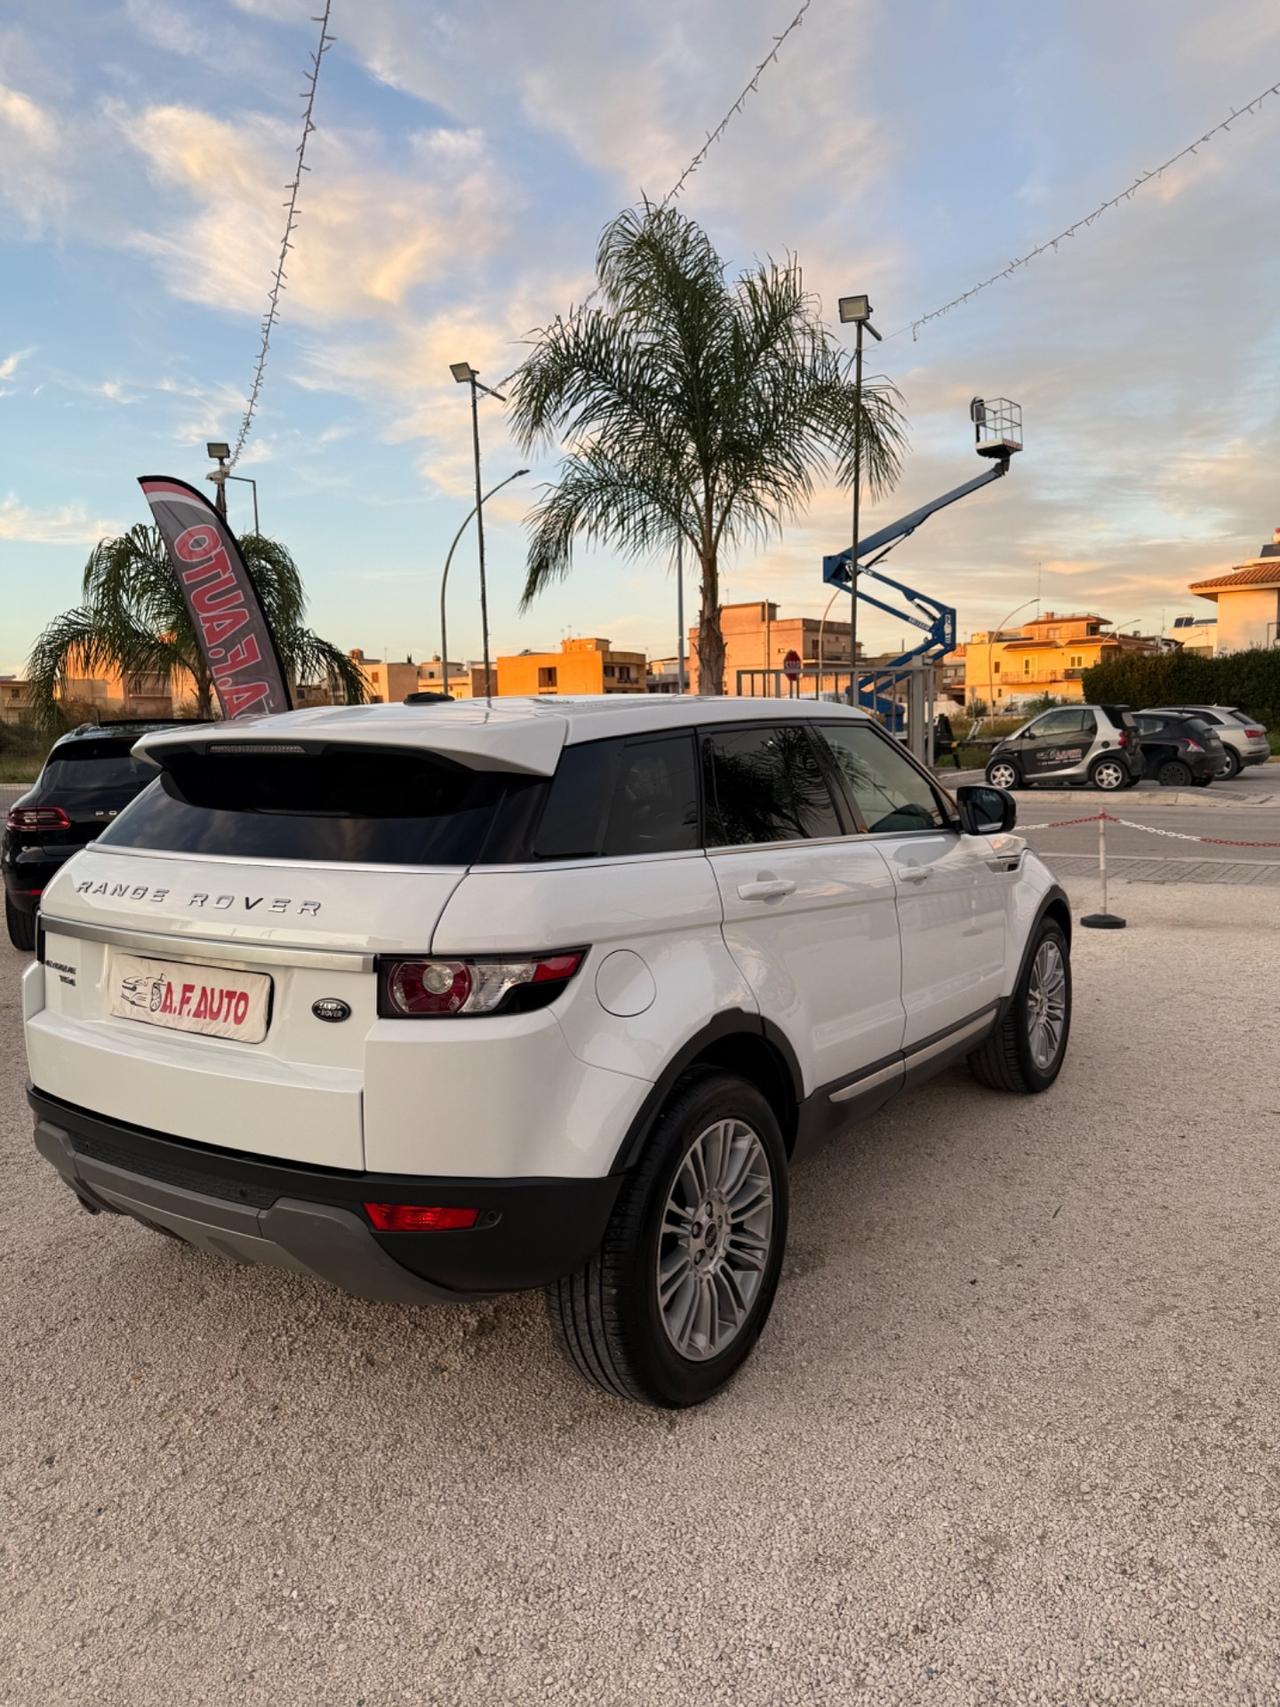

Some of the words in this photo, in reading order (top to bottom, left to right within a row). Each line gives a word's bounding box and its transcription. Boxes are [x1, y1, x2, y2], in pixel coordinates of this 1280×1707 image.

[76, 881, 170, 903] RANGE
[188, 893, 321, 917] ROVER
[160, 981, 250, 1026] A.F.AUTO
[319, 1002, 338, 1010] LAND
